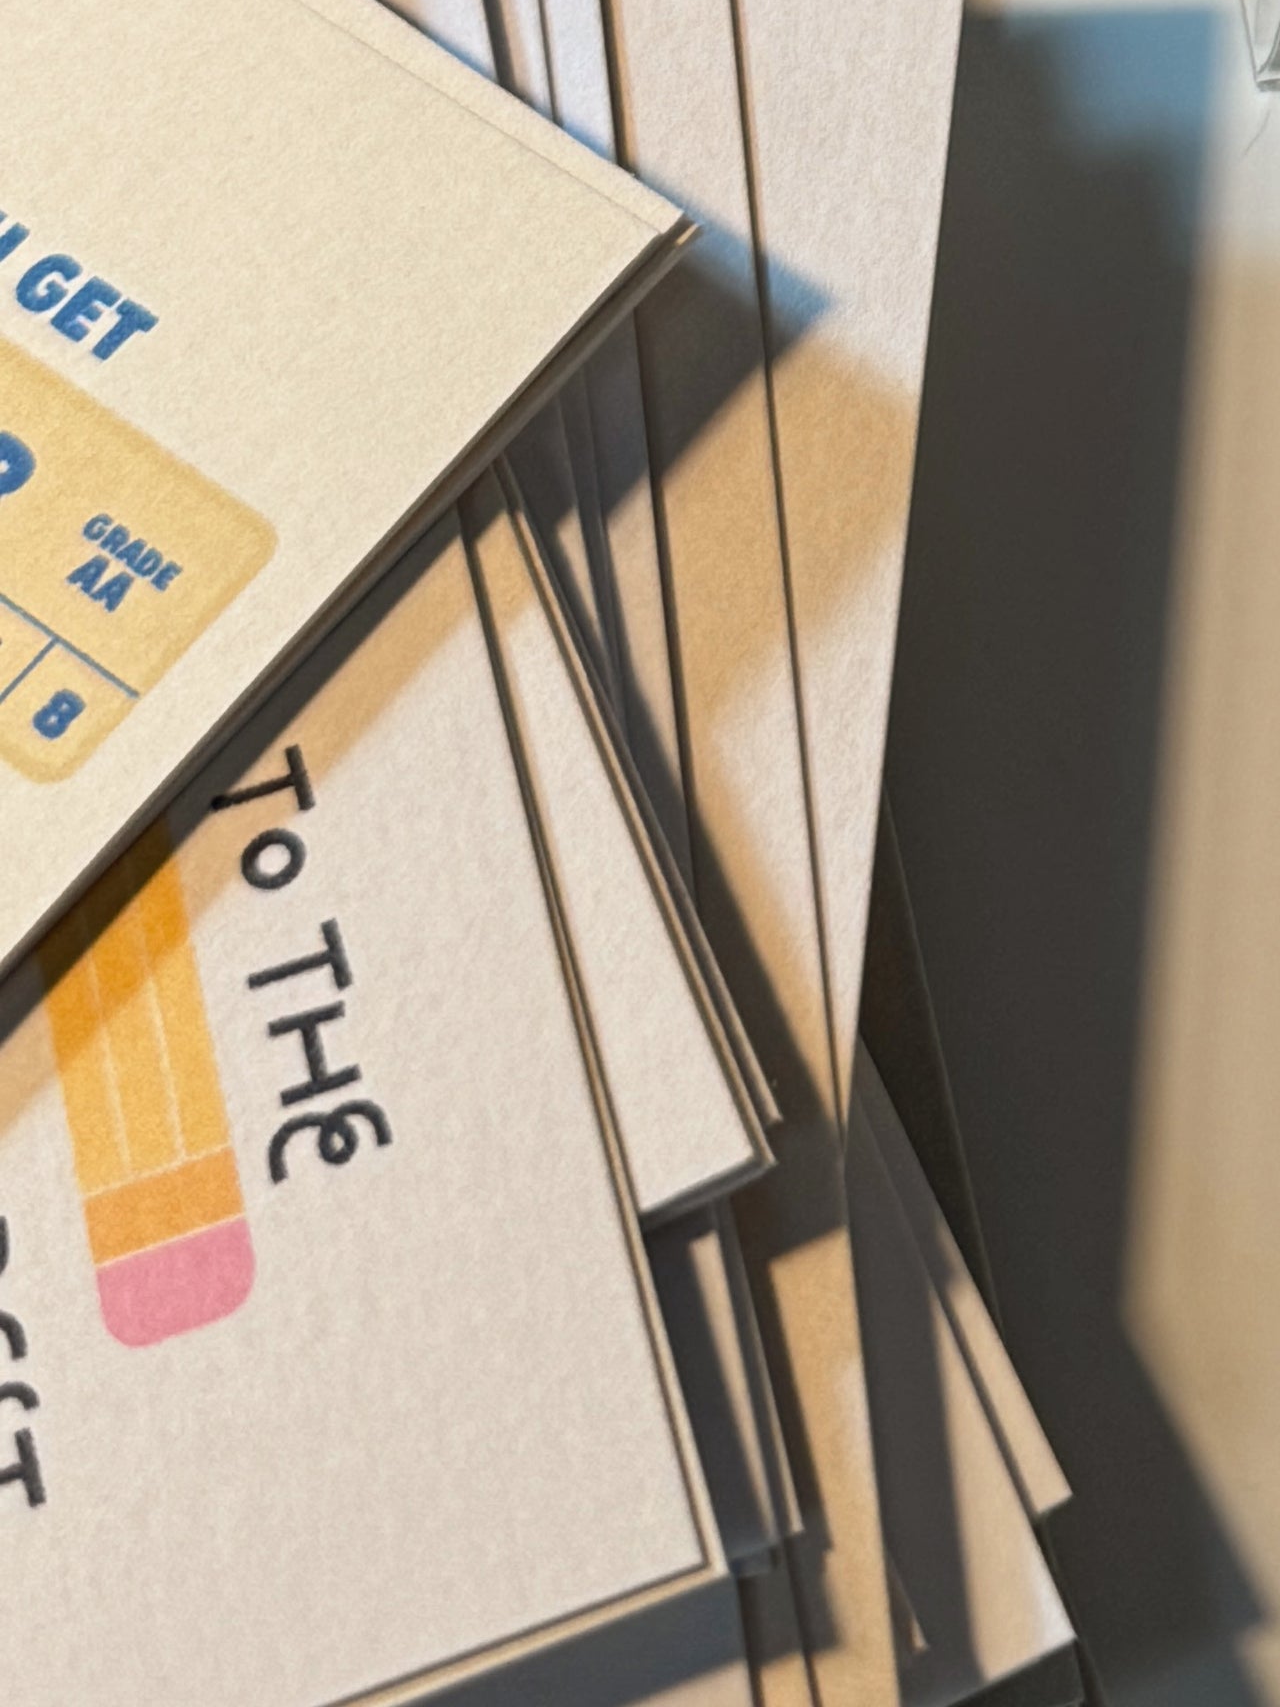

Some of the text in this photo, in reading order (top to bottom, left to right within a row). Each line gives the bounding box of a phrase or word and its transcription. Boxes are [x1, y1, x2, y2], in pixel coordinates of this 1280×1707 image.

[17, 253, 160, 362] GET
[66, 559, 135, 613] AA
[82, 513, 183, 592] GRADE
[32, 689, 87, 741] 8
[209, 744, 392, 1185] TO THE
